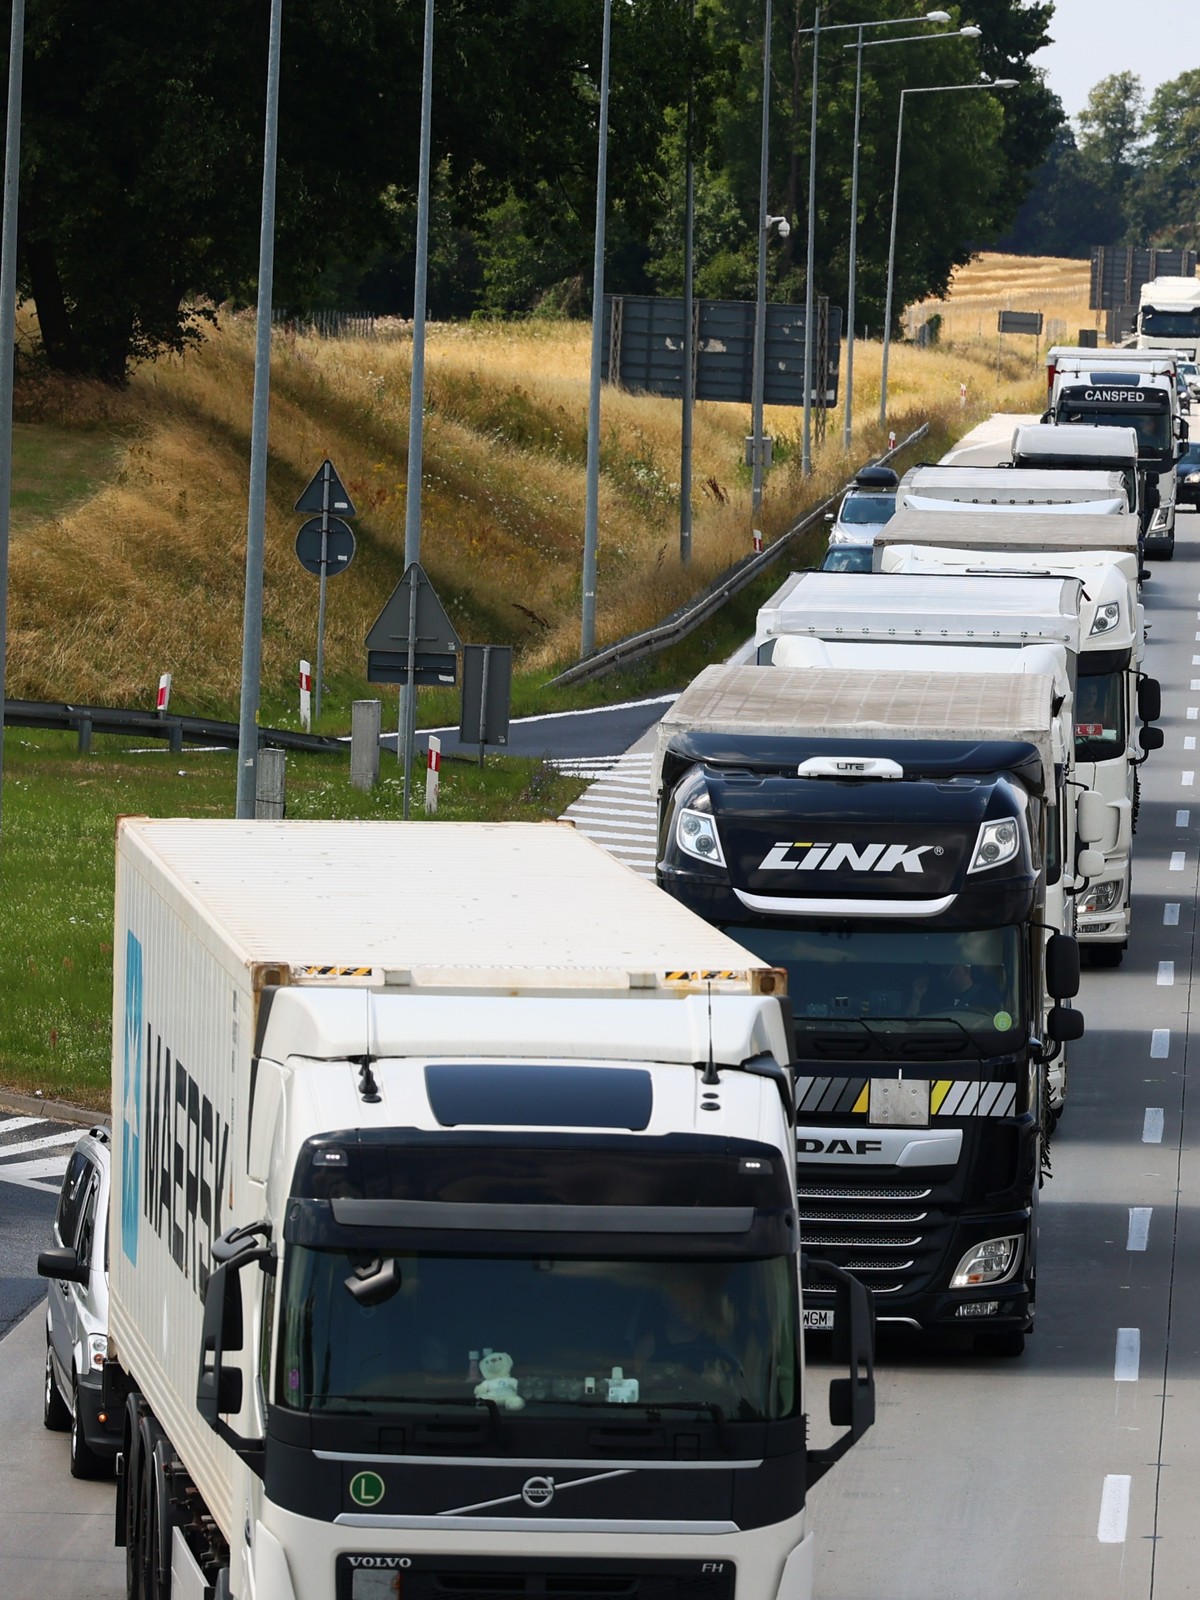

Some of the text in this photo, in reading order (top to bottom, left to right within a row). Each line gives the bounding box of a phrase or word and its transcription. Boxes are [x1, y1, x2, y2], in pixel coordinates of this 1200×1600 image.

[1084, 390, 1145, 402] CANSPED
[837, 763, 865, 771] LITE
[797, 1138, 882, 1155] DAF
[360, 1478, 375, 1499] L
[524, 1488, 553, 1496] VOLVO
[346, 1556, 412, 1568] VOLVO
[701, 1563, 724, 1573] FH
